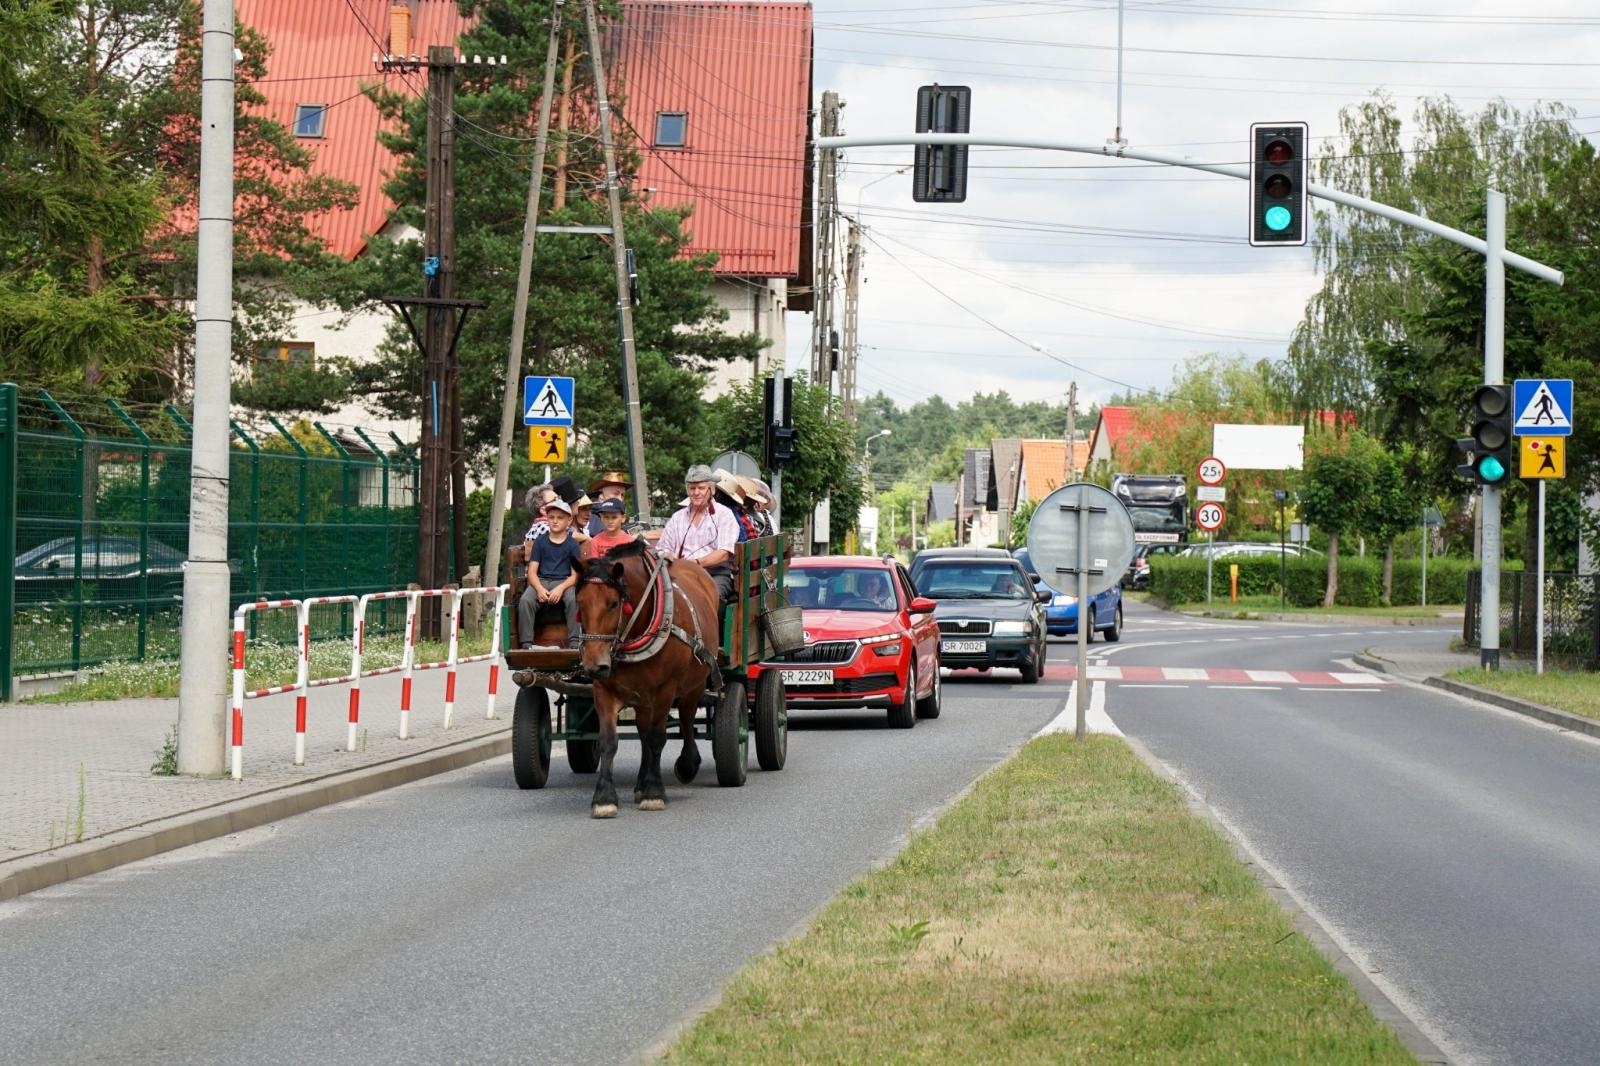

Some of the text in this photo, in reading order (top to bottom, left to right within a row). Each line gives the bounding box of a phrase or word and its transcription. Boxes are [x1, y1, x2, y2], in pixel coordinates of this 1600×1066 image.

[1201, 509, 1221, 523] 30
[944, 641, 984, 650] SR 7002F
[780, 670, 831, 682] SR 2229N
